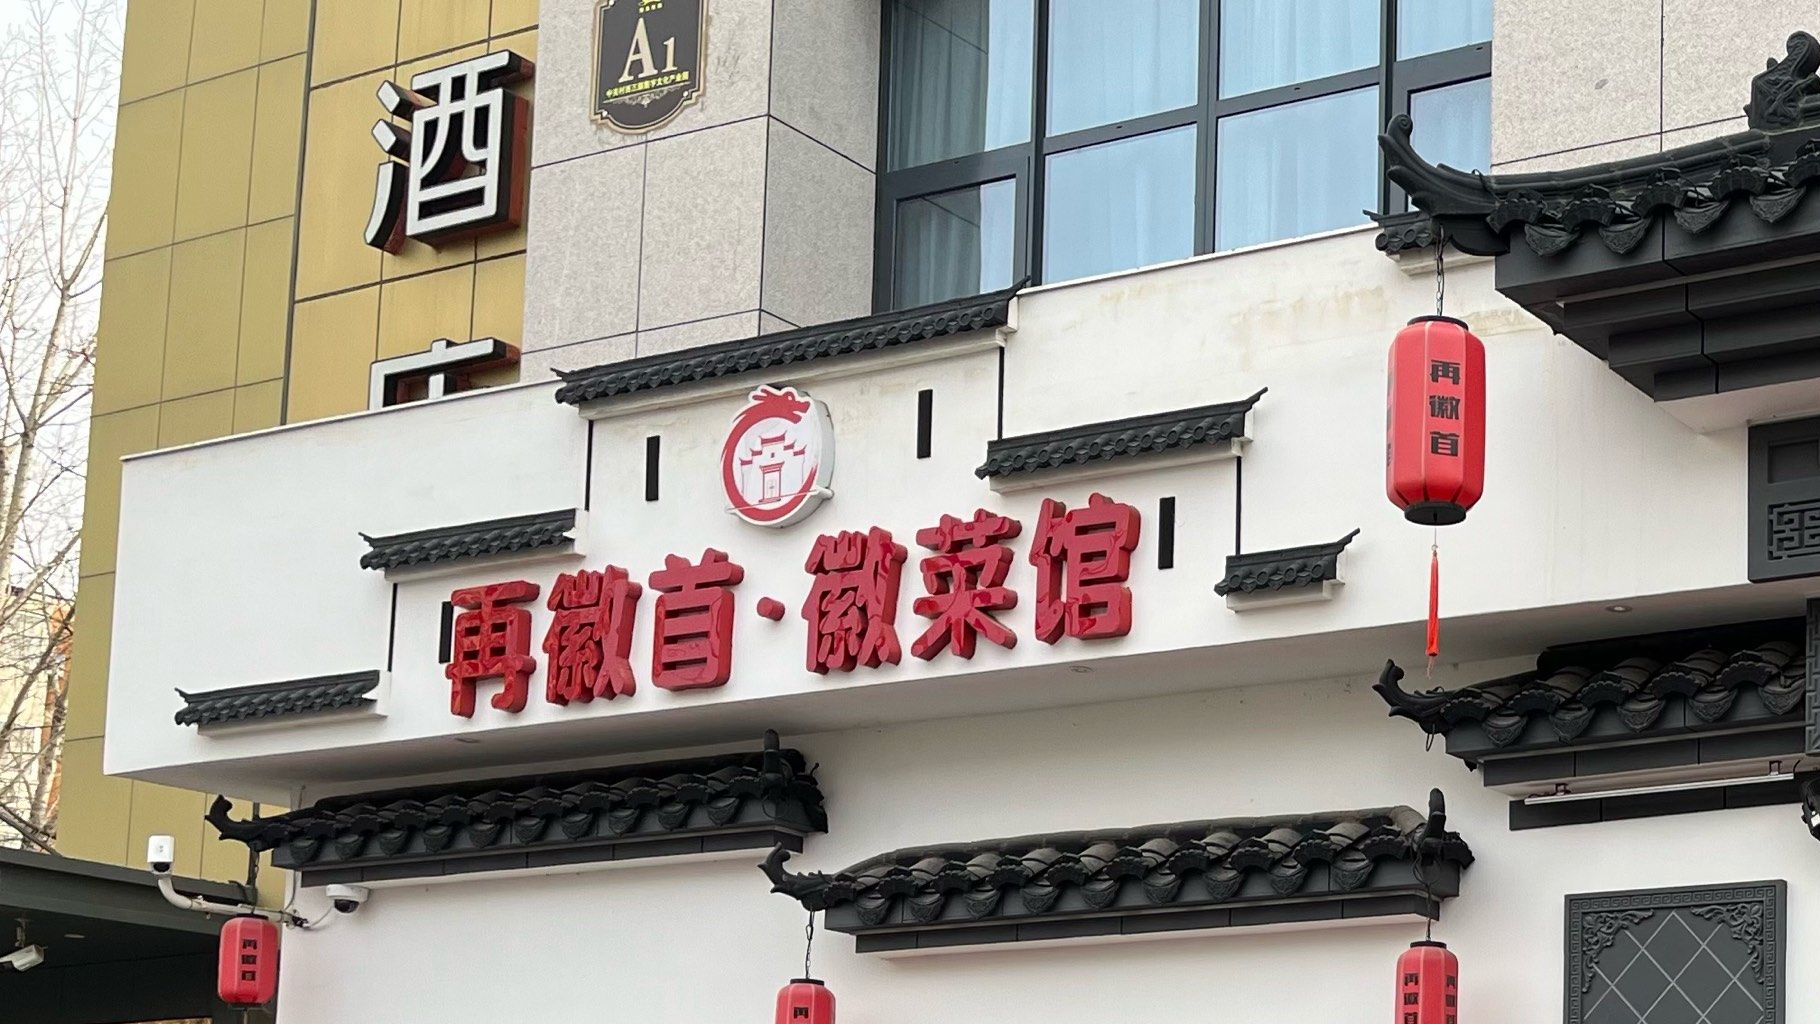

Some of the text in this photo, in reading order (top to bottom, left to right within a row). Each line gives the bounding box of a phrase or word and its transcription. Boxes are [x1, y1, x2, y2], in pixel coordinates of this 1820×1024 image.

[618, 17, 678, 83] A1
[1429, 358, 1461, 457] 再徽首
